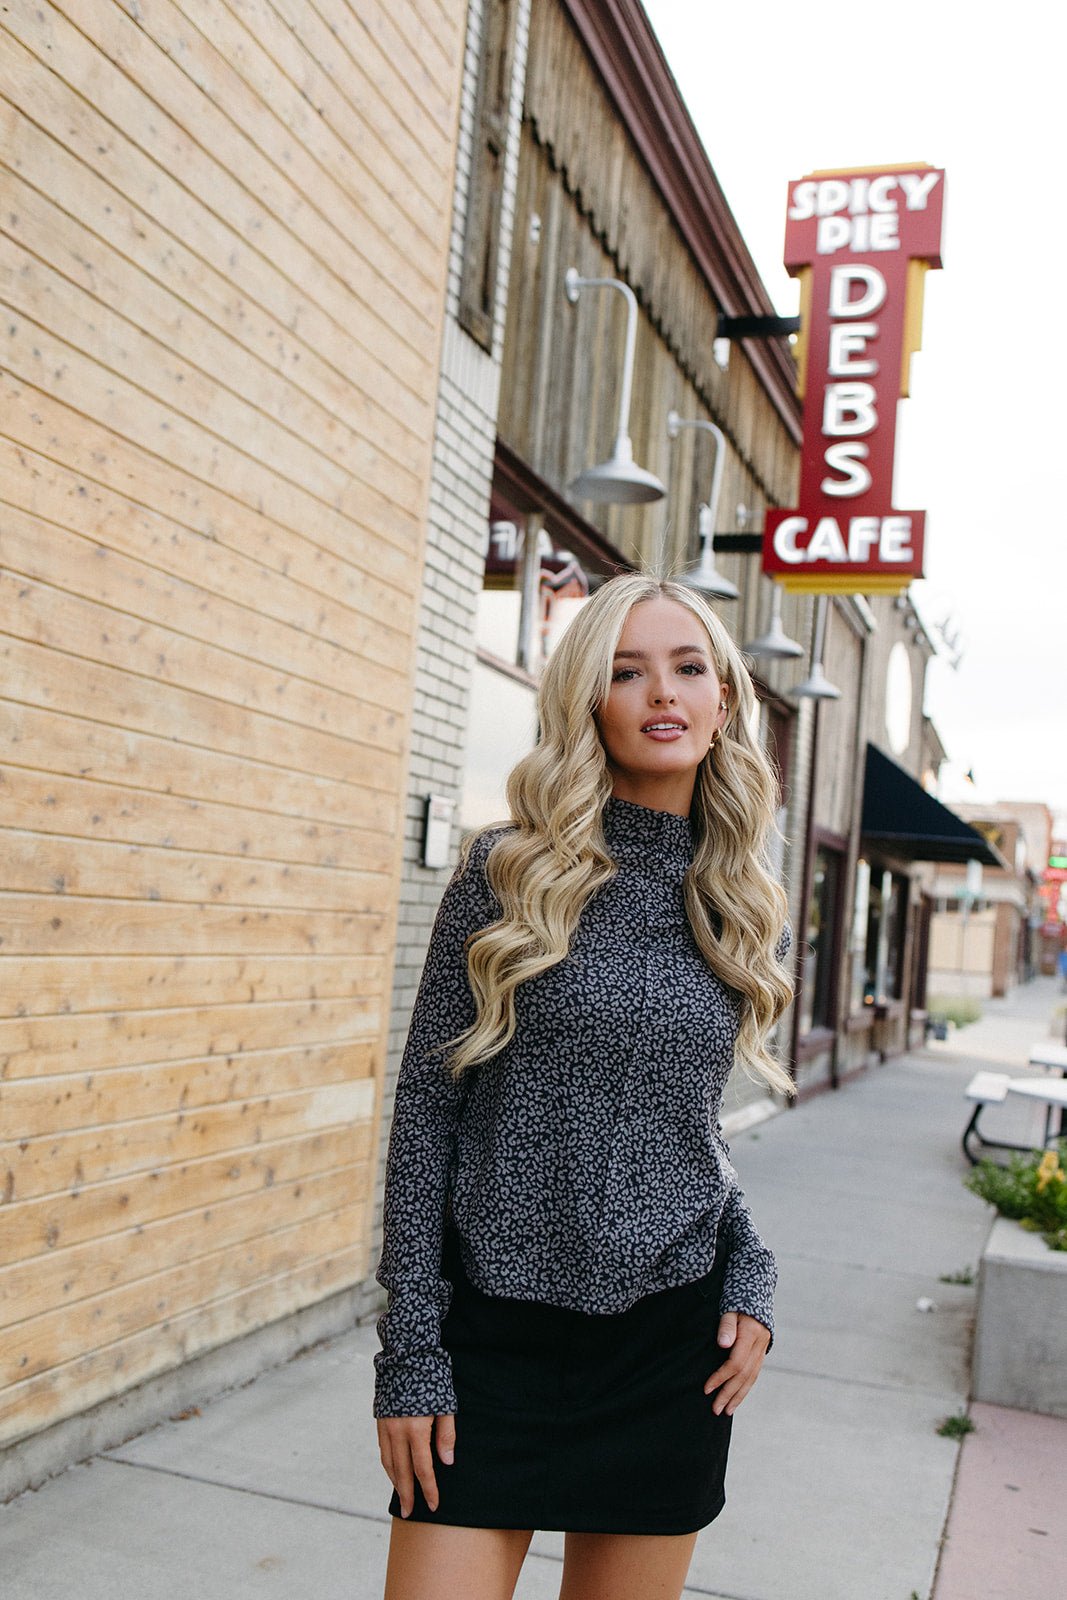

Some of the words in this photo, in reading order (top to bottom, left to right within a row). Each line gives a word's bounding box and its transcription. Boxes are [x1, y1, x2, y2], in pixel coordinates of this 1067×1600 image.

[788, 172, 940, 221] SPICY
[816, 211, 900, 255] PIE
[821, 263, 887, 497] DEBS
[773, 516, 913, 563] CAFE
